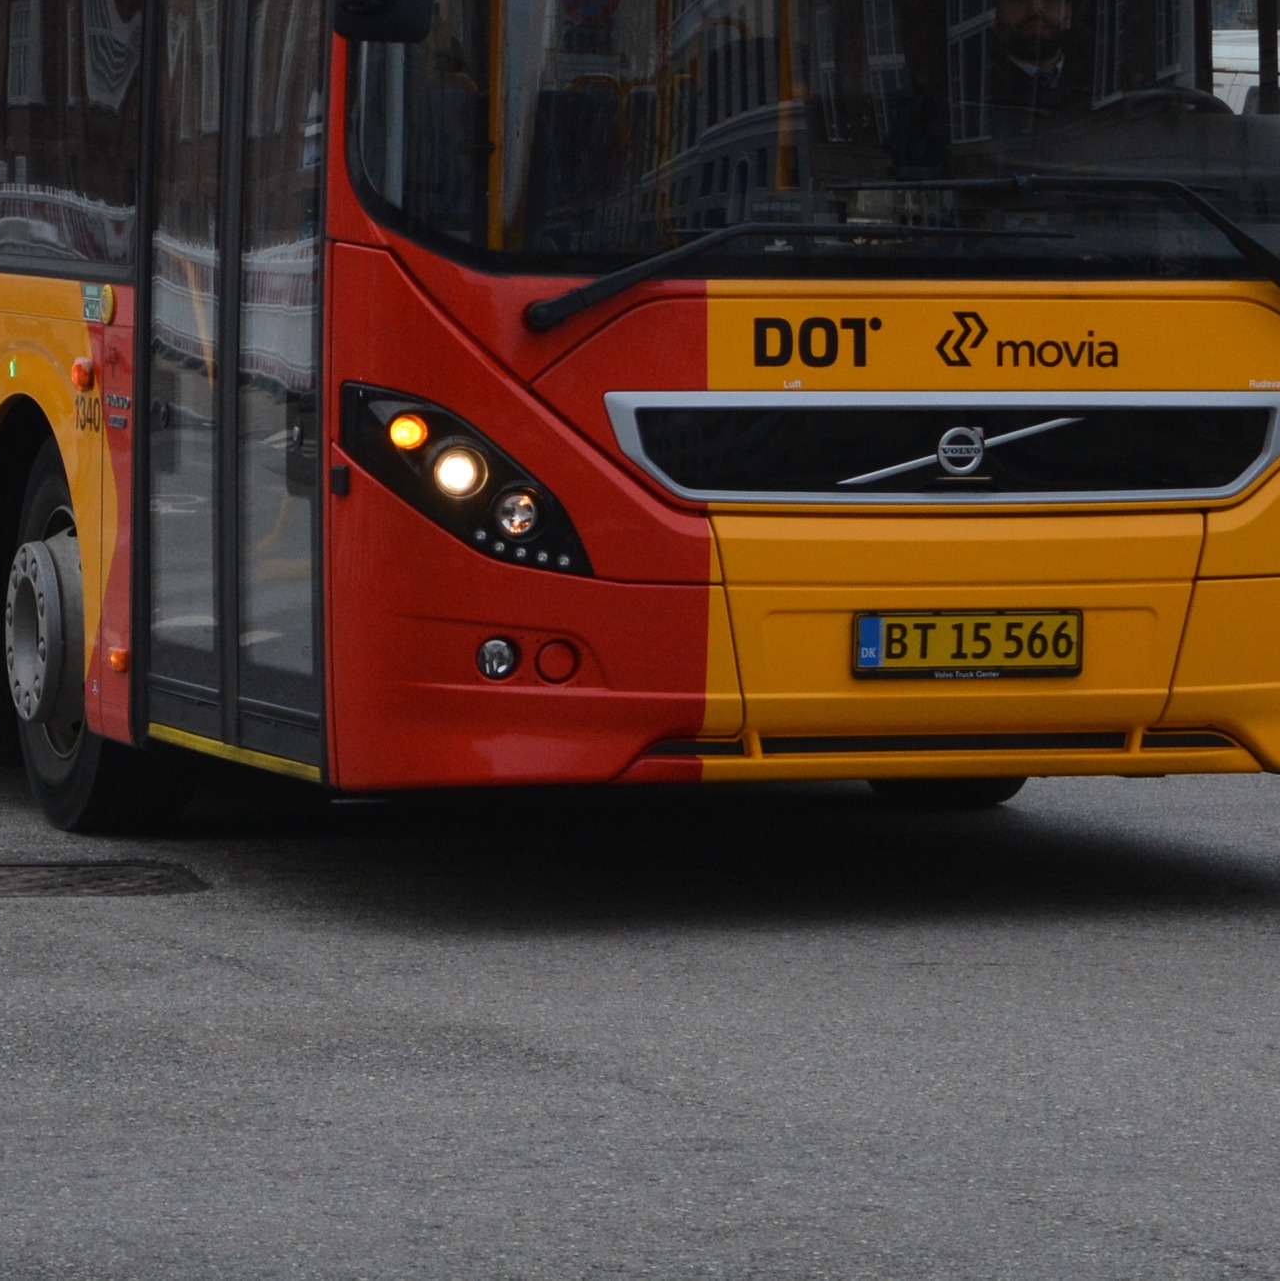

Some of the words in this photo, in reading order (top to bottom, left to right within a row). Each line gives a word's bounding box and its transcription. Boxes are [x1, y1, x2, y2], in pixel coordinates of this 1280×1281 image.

[753, 316, 882, 367] DOT
[996, 330, 1120, 368] movia
[783, 379, 803, 389] Luft
[75, 393, 102, 434] 1340
[941, 446, 982, 455] VOLVO
[861, 647, 877, 659] DK
[885, 623, 937, 660] BT
[951, 622, 992, 660] 15
[1003, 621, 1074, 660] 566
[934, 671, 954, 679] Volvo
[955, 671, 974, 679] Truck
[976, 670, 1000, 679] Center
